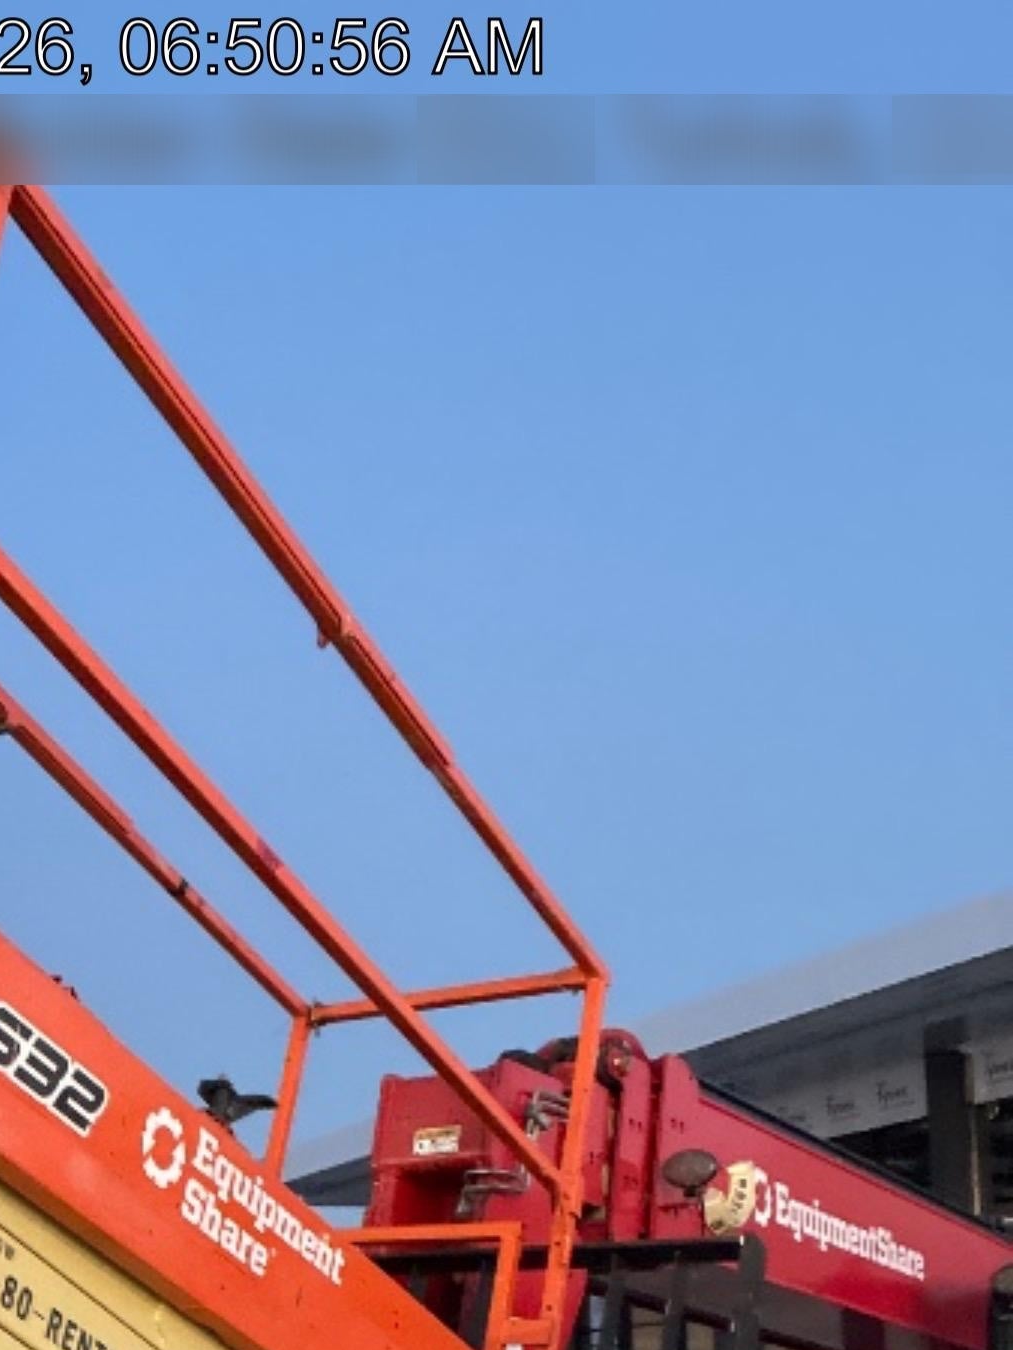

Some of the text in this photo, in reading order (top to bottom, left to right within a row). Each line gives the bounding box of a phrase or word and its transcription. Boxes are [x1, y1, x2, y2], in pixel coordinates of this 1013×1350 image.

[181, 1178, 268, 1277] Share
[192, 1126, 345, 1286] Equipment
[774, 1181, 926, 1281] EquipmentShare
